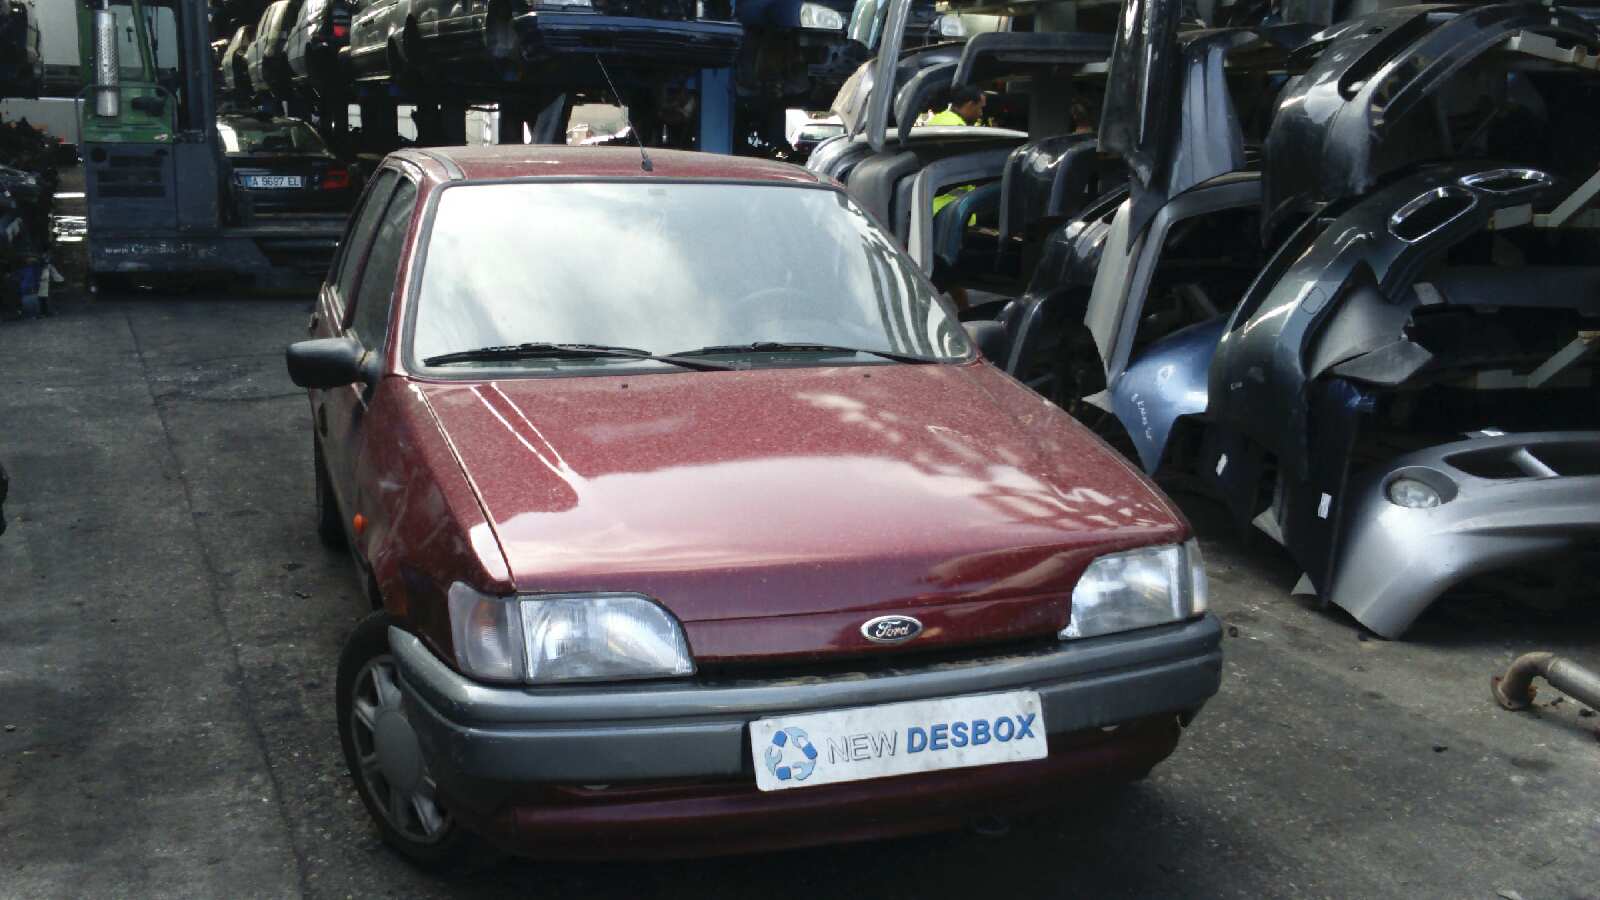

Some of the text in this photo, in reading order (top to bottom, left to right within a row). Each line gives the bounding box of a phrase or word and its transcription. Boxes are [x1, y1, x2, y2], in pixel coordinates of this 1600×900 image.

[287, 176, 300, 186] EL
[875, 620, 910, 637] Ford
[825, 713, 1036, 764] NEW DESBOX
